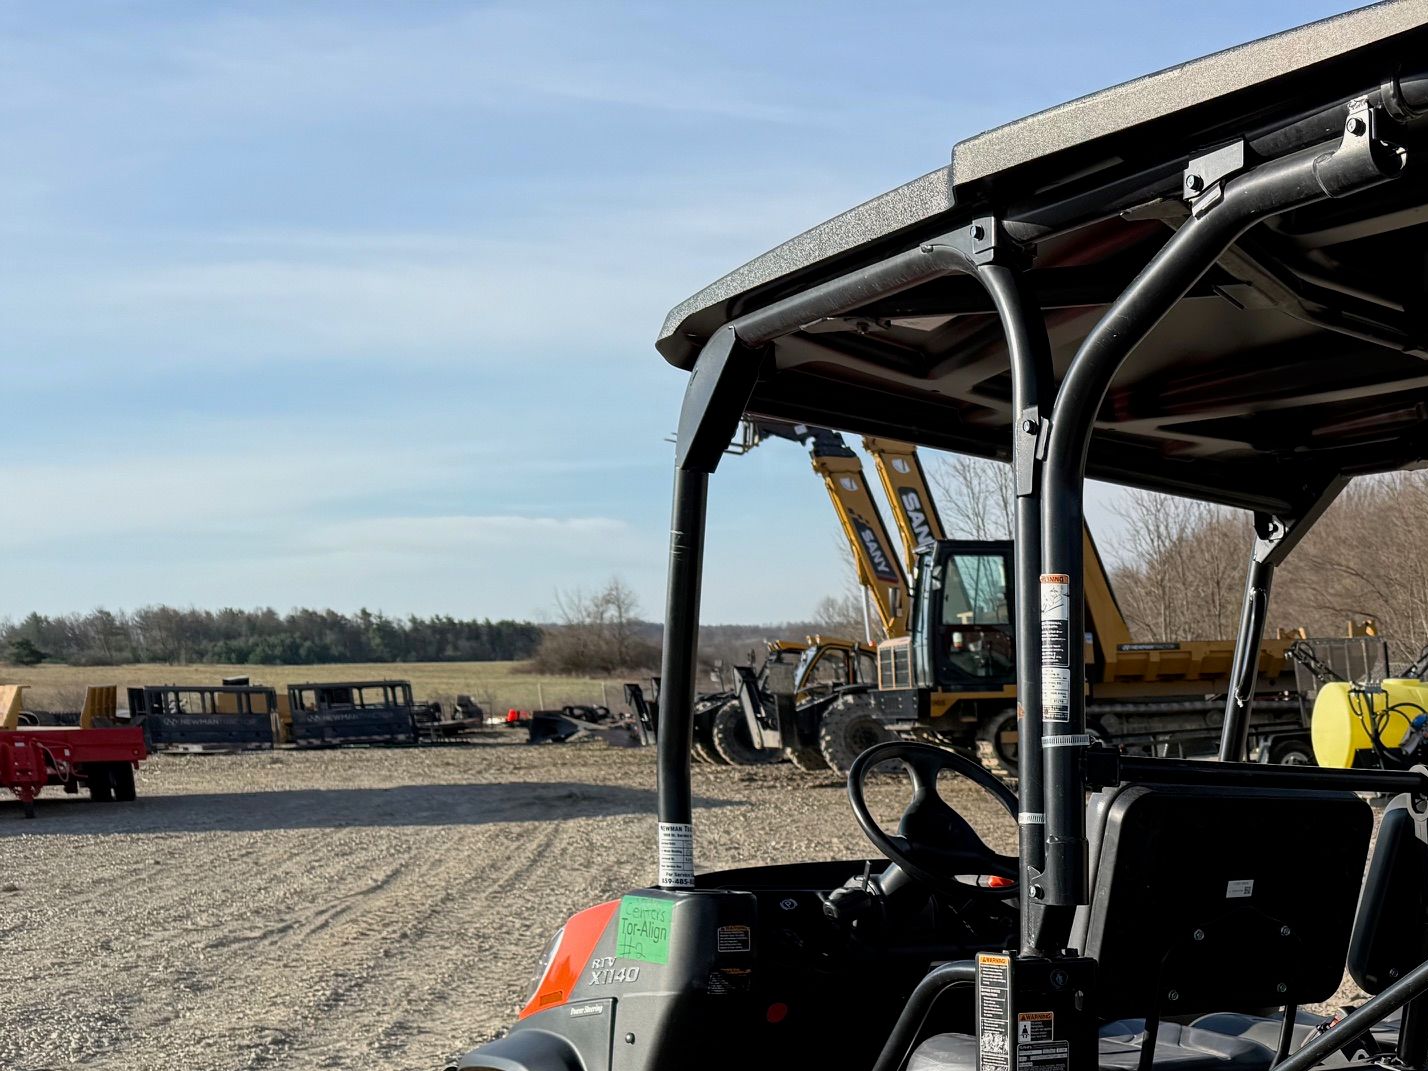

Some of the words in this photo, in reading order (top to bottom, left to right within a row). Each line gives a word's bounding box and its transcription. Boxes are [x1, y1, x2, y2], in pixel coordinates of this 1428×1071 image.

[902, 492, 936, 548] SAN
[861, 529, 890, 572] SANY
[621, 917, 667, 943] Tor-Align
[591, 956, 617, 969] RTV
[589, 966, 641, 986] X1140
[1026, 1013, 1052, 1021] WARNING
